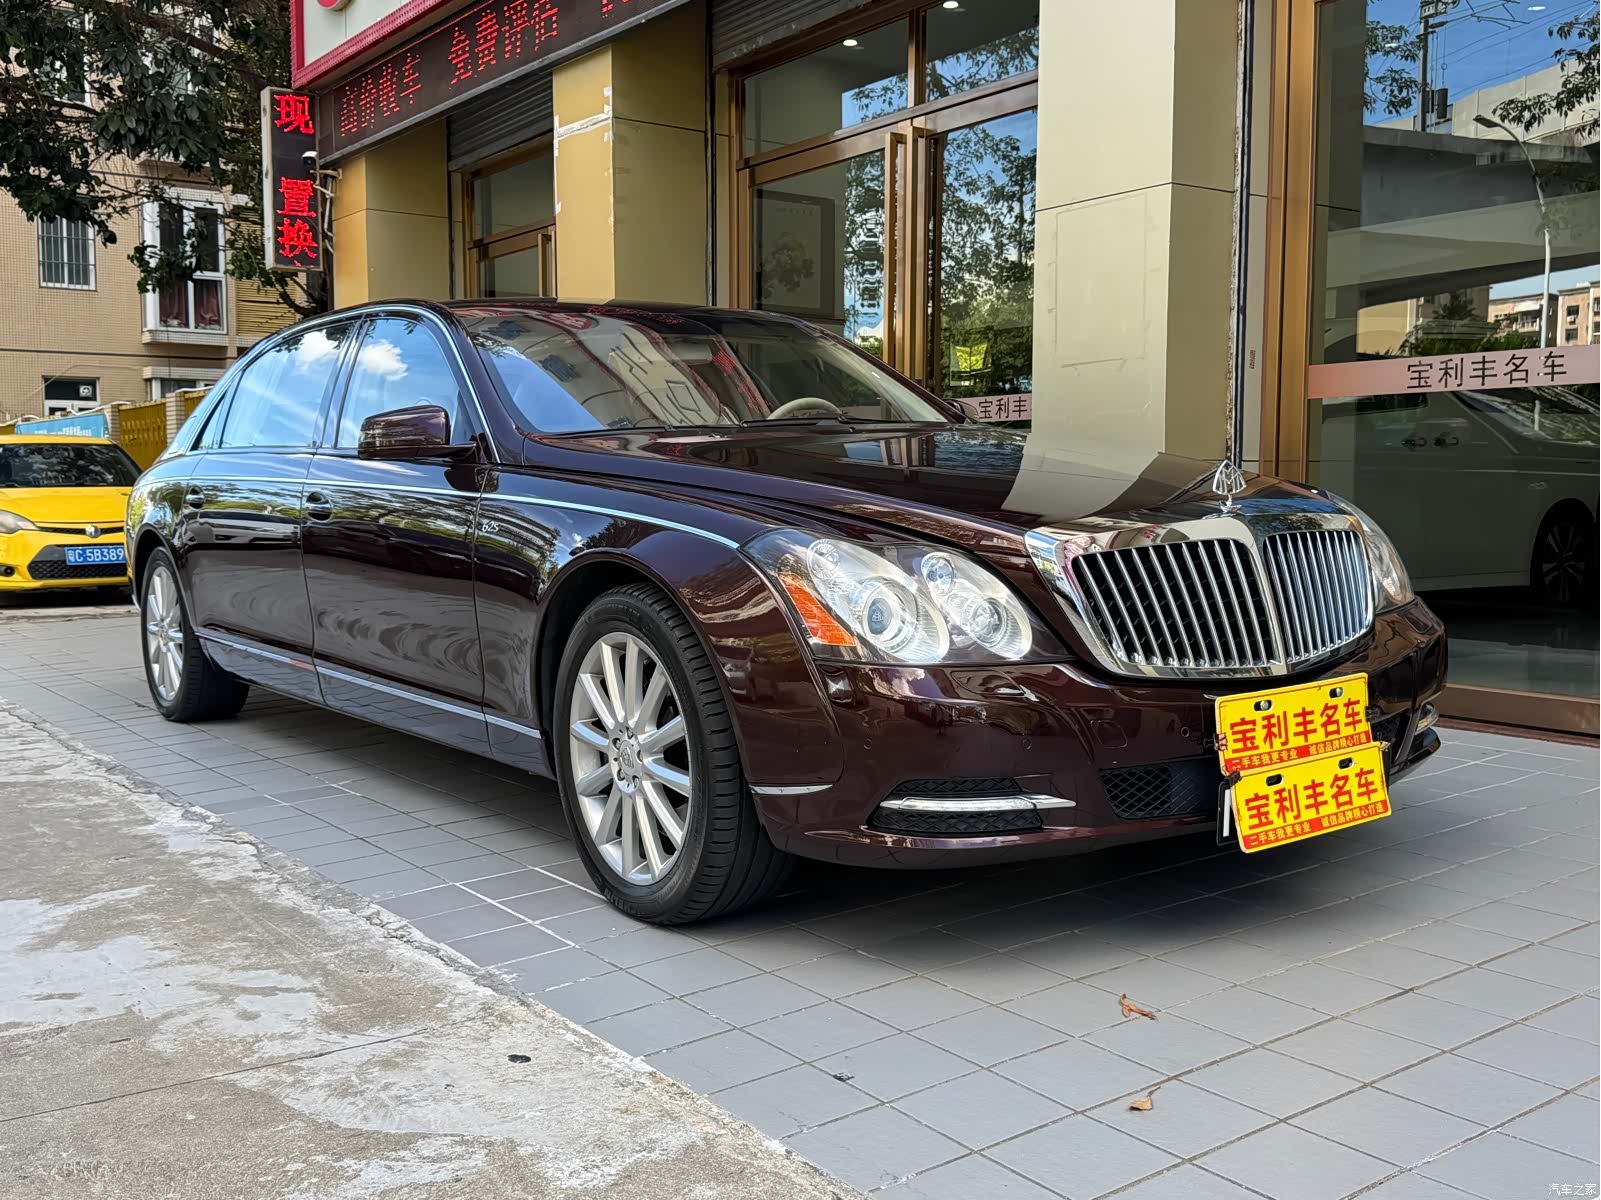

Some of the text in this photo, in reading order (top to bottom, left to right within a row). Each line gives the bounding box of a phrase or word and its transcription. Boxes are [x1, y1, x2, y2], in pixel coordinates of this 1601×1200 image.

[273, 94, 318, 258] 现 置换
[1406, 350, 1567, 389] 宝利丰名车
[978, 396, 1033, 419] 宝利丰
[1229, 698, 1363, 754] 宝利丰名车
[1231, 733, 1367, 769] 二手车我更专业 诚信品牌精心打造
[1244, 767, 1378, 831] 宝利丰名车
[1249, 803, 1384, 845] 二手车我更专业 诚信品牌精心打造
